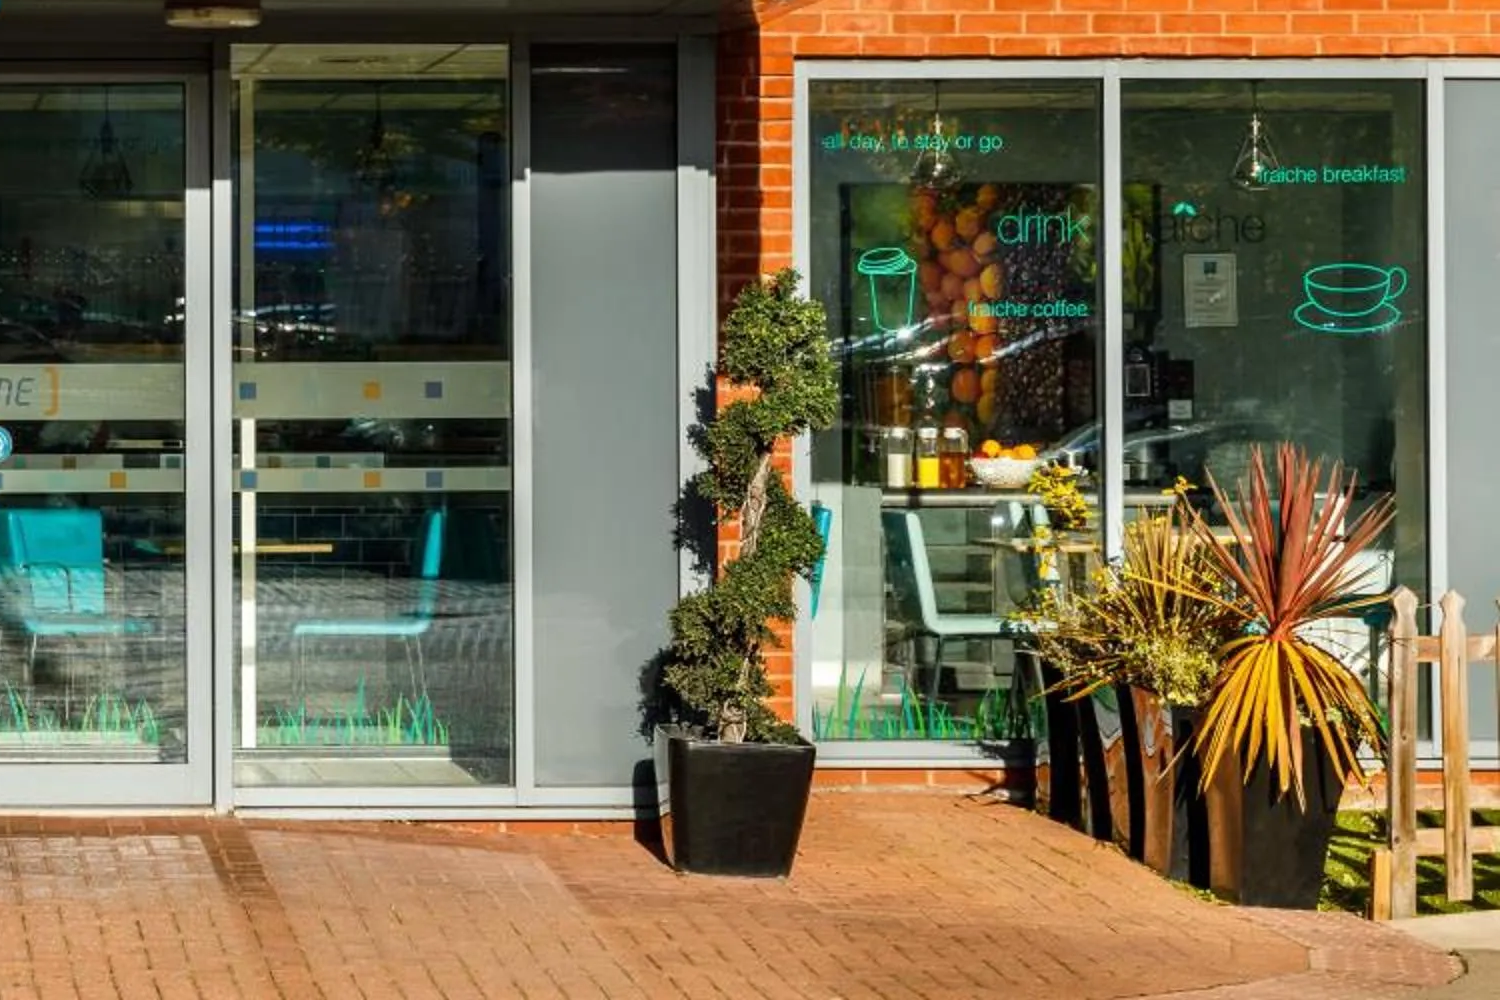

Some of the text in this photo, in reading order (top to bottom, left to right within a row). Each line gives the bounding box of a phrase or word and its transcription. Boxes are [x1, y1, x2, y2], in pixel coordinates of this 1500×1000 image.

[891, 134, 909, 149] to
[913, 134, 949, 153] stay
[955, 136, 973, 149] or
[1323, 165, 1406, 183] breakfast
[997, 205, 1090, 244] drink
[1033, 299, 1089, 317] coffee
